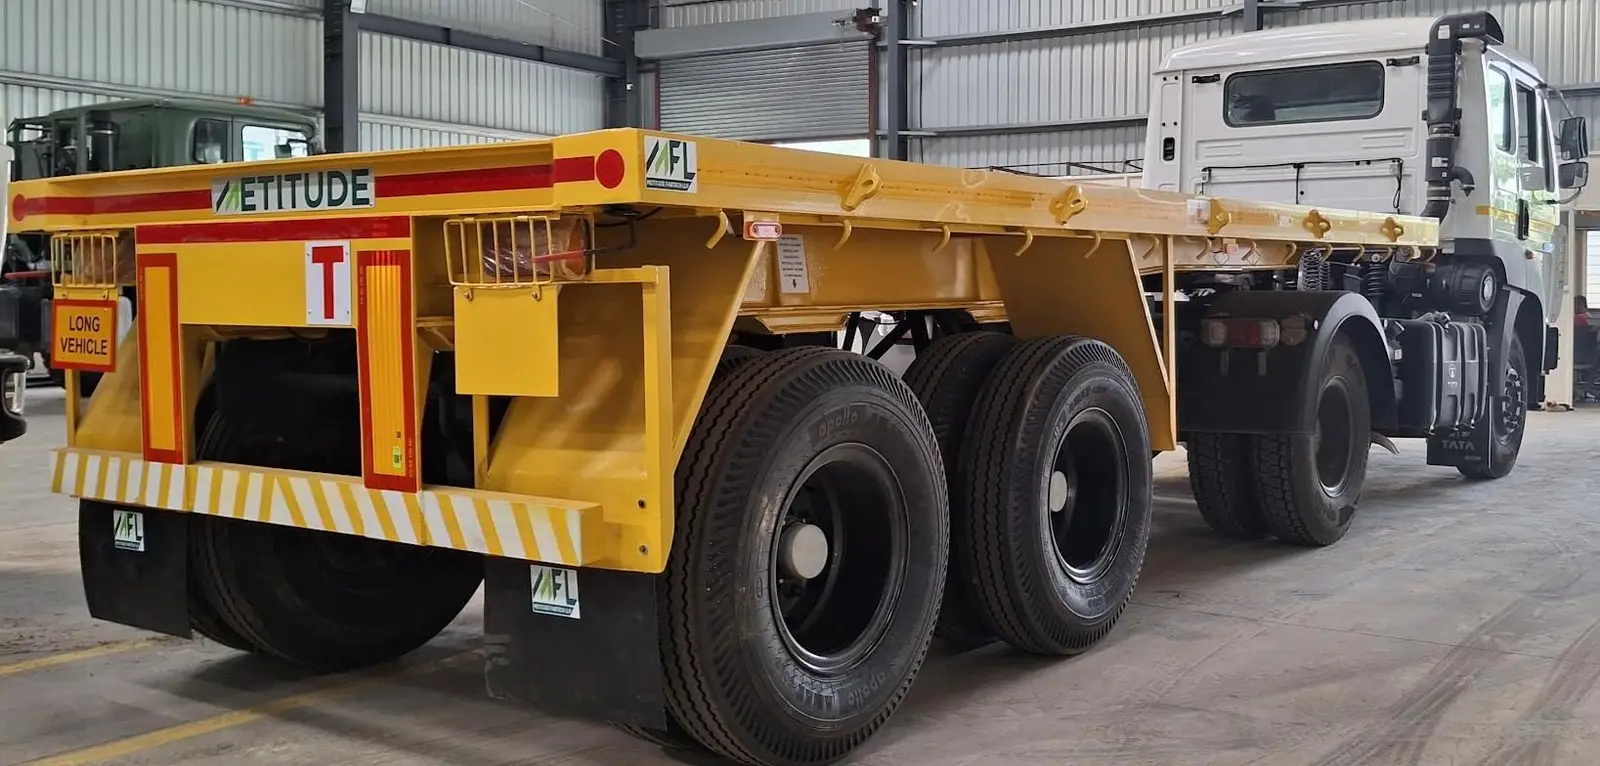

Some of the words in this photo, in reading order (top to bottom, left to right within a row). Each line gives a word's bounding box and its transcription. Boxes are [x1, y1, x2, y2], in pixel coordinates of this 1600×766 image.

[646, 139, 696, 180] MFL
[216, 169, 370, 212] METITUDE
[312, 246, 344, 319] T
[69, 315, 100, 332] LONG
[61, 337, 108, 355] VEHICLE
[818, 407, 858, 437] apollo
[1441, 439, 1475, 450] TATA
[533, 568, 577, 605] MFL
